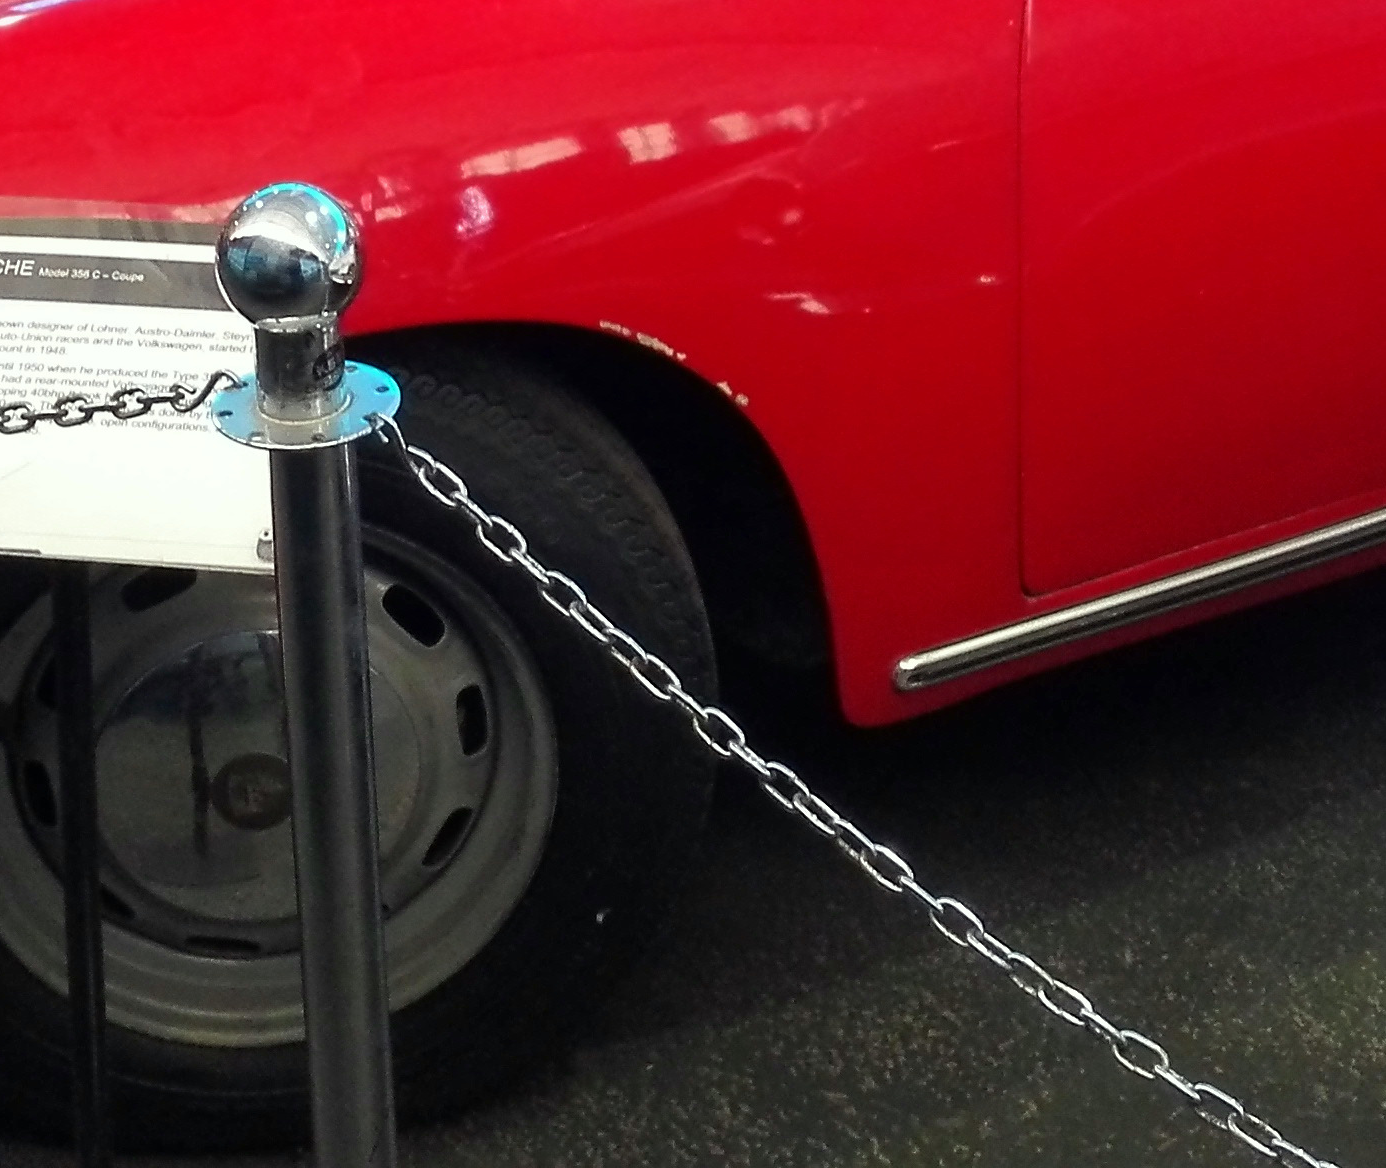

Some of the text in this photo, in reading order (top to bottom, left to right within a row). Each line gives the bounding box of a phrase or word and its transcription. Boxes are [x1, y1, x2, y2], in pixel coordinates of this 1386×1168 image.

[39, 266, 70, 279] Model
[71, 268, 90, 279] 356
[92, 269, 101, 279] C
[25, 320, 74, 332] designer
[54, 336, 90, 344] racers
[91, 336, 115, 345] and
[114, 337, 134, 346] the
[207, 343, 248, 353] started
[45, 364, 78, 373] when
[94, 367, 149, 379] produced
[149, 370, 169, 378] the
[170, 371, 198, 381] Type
